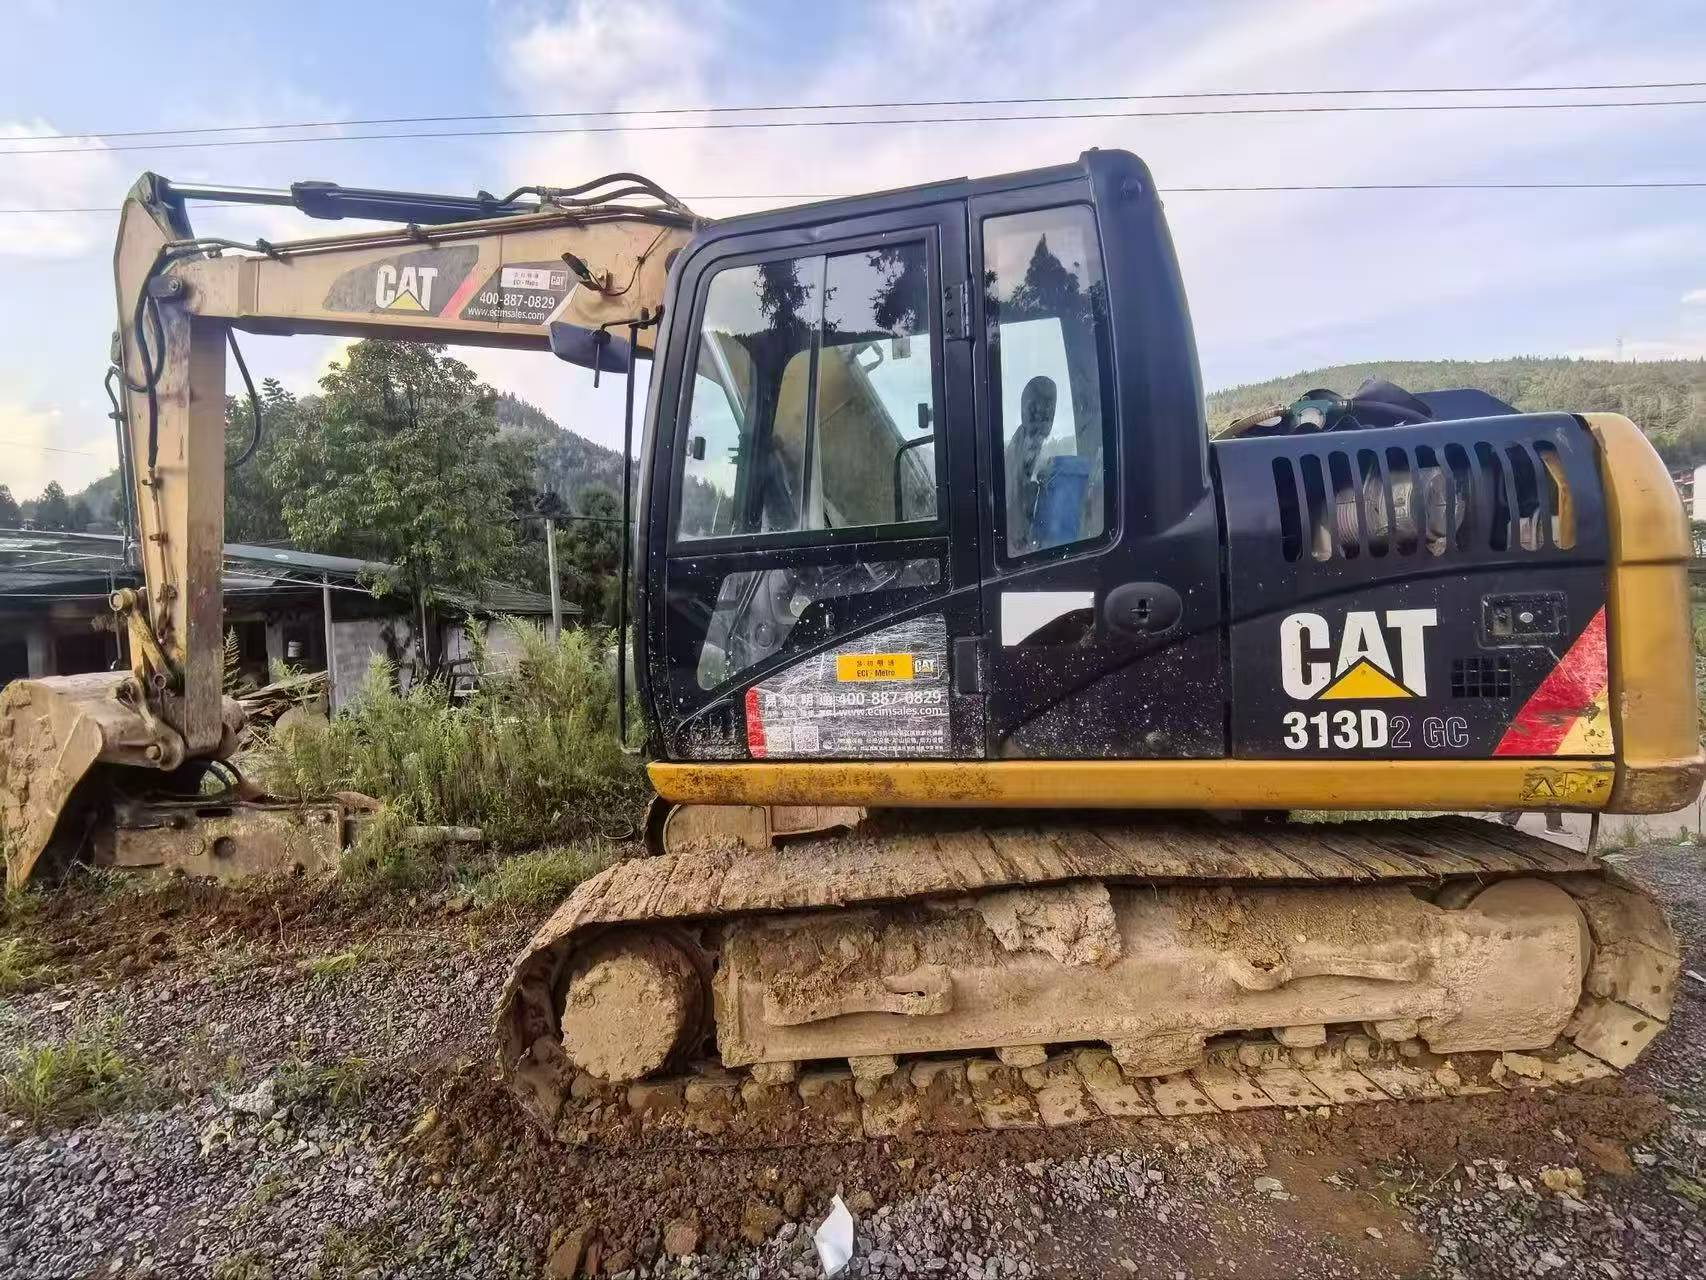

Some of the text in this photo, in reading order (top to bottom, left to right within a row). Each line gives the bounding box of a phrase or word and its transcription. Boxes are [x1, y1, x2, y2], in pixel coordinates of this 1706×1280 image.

[376, 264, 438, 311] CAT
[480, 291, 555, 309] 400-887-0829
[468, 306, 545, 320] www.ecimsales.com
[1280, 609, 1438, 700] CAT
[914, 659, 935, 673] CAT
[836, 690, 942, 707] 400-887-0829
[838, 705, 943, 718] www.ecimsales.com
[1422, 716, 1470, 749] GC
